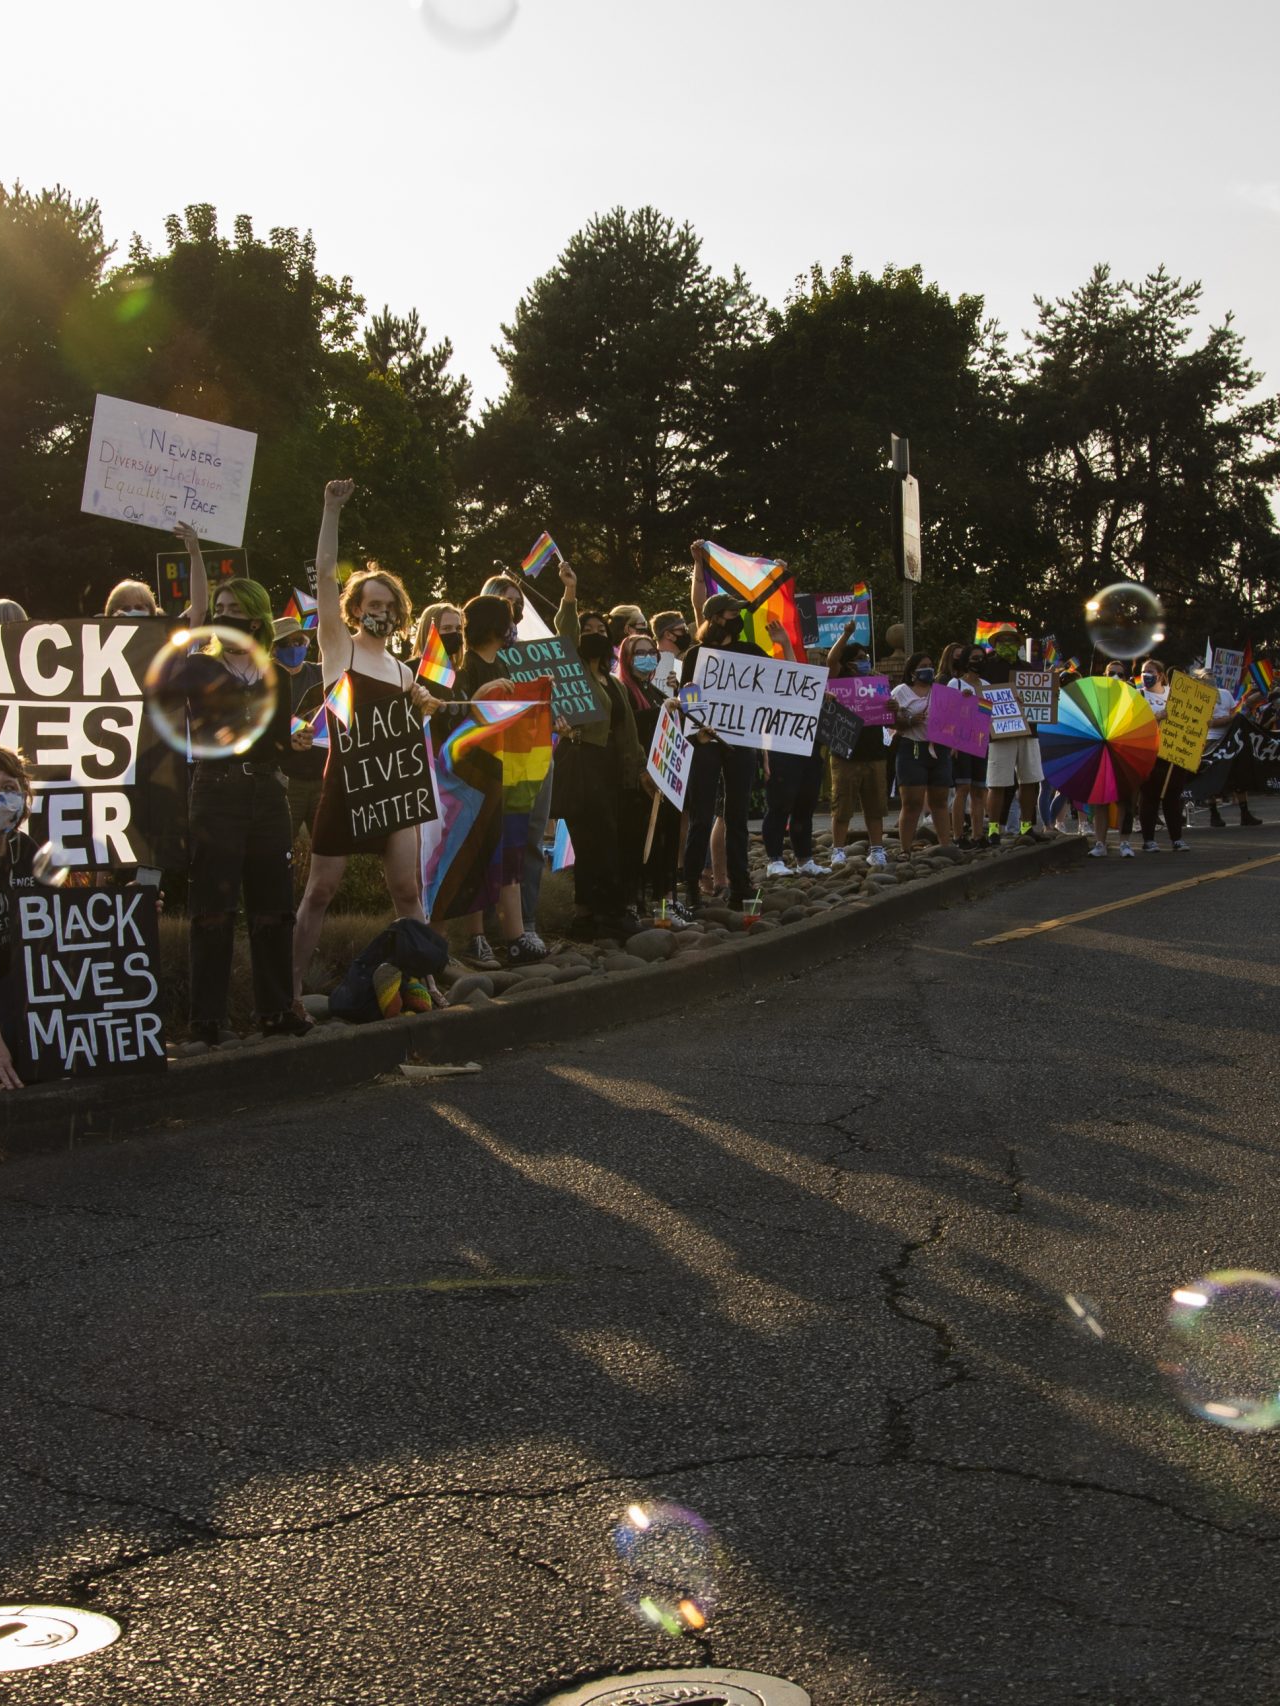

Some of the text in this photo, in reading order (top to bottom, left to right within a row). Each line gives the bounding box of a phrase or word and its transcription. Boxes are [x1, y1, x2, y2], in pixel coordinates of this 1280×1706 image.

[149, 428, 222, 468] NEWBERG
[183, 485, 218, 515] PEACE
[165, 558, 235, 580] BLCK
[822, 594, 855, 605] AUGUST
[818, 621, 867, 632] MEMOAL
[830, 632, 856, 641] PAK
[526, 640, 566, 663] ONE
[557, 662, 584, 678] DIE
[703, 655, 765, 694] BLACK
[774, 668, 821, 700] LIVES
[1017, 673, 1050, 686] STOP
[551, 679, 592, 698] LICE
[984, 690, 1013, 702] BLACK
[1019, 690, 1049, 703] ASIAN
[1174, 677, 1191, 695] Our
[551, 694, 597, 717] TODY
[991, 703, 1017, 716] LIVES
[1026, 707, 1049, 721] ATE
[336, 697, 421, 753] BLACK
[661, 711, 689, 758] BLACK
[750, 706, 818, 742] MATTER
[657, 733, 683, 773] LIVES
[343, 743, 424, 793] LIVES
[652, 747, 683, 796] MATTER
[351, 787, 432, 837] MATTER
[19, 892, 145, 952] BLACK
[24, 945, 159, 1010] LIVES
[27, 1010, 165, 1070] MATTER
